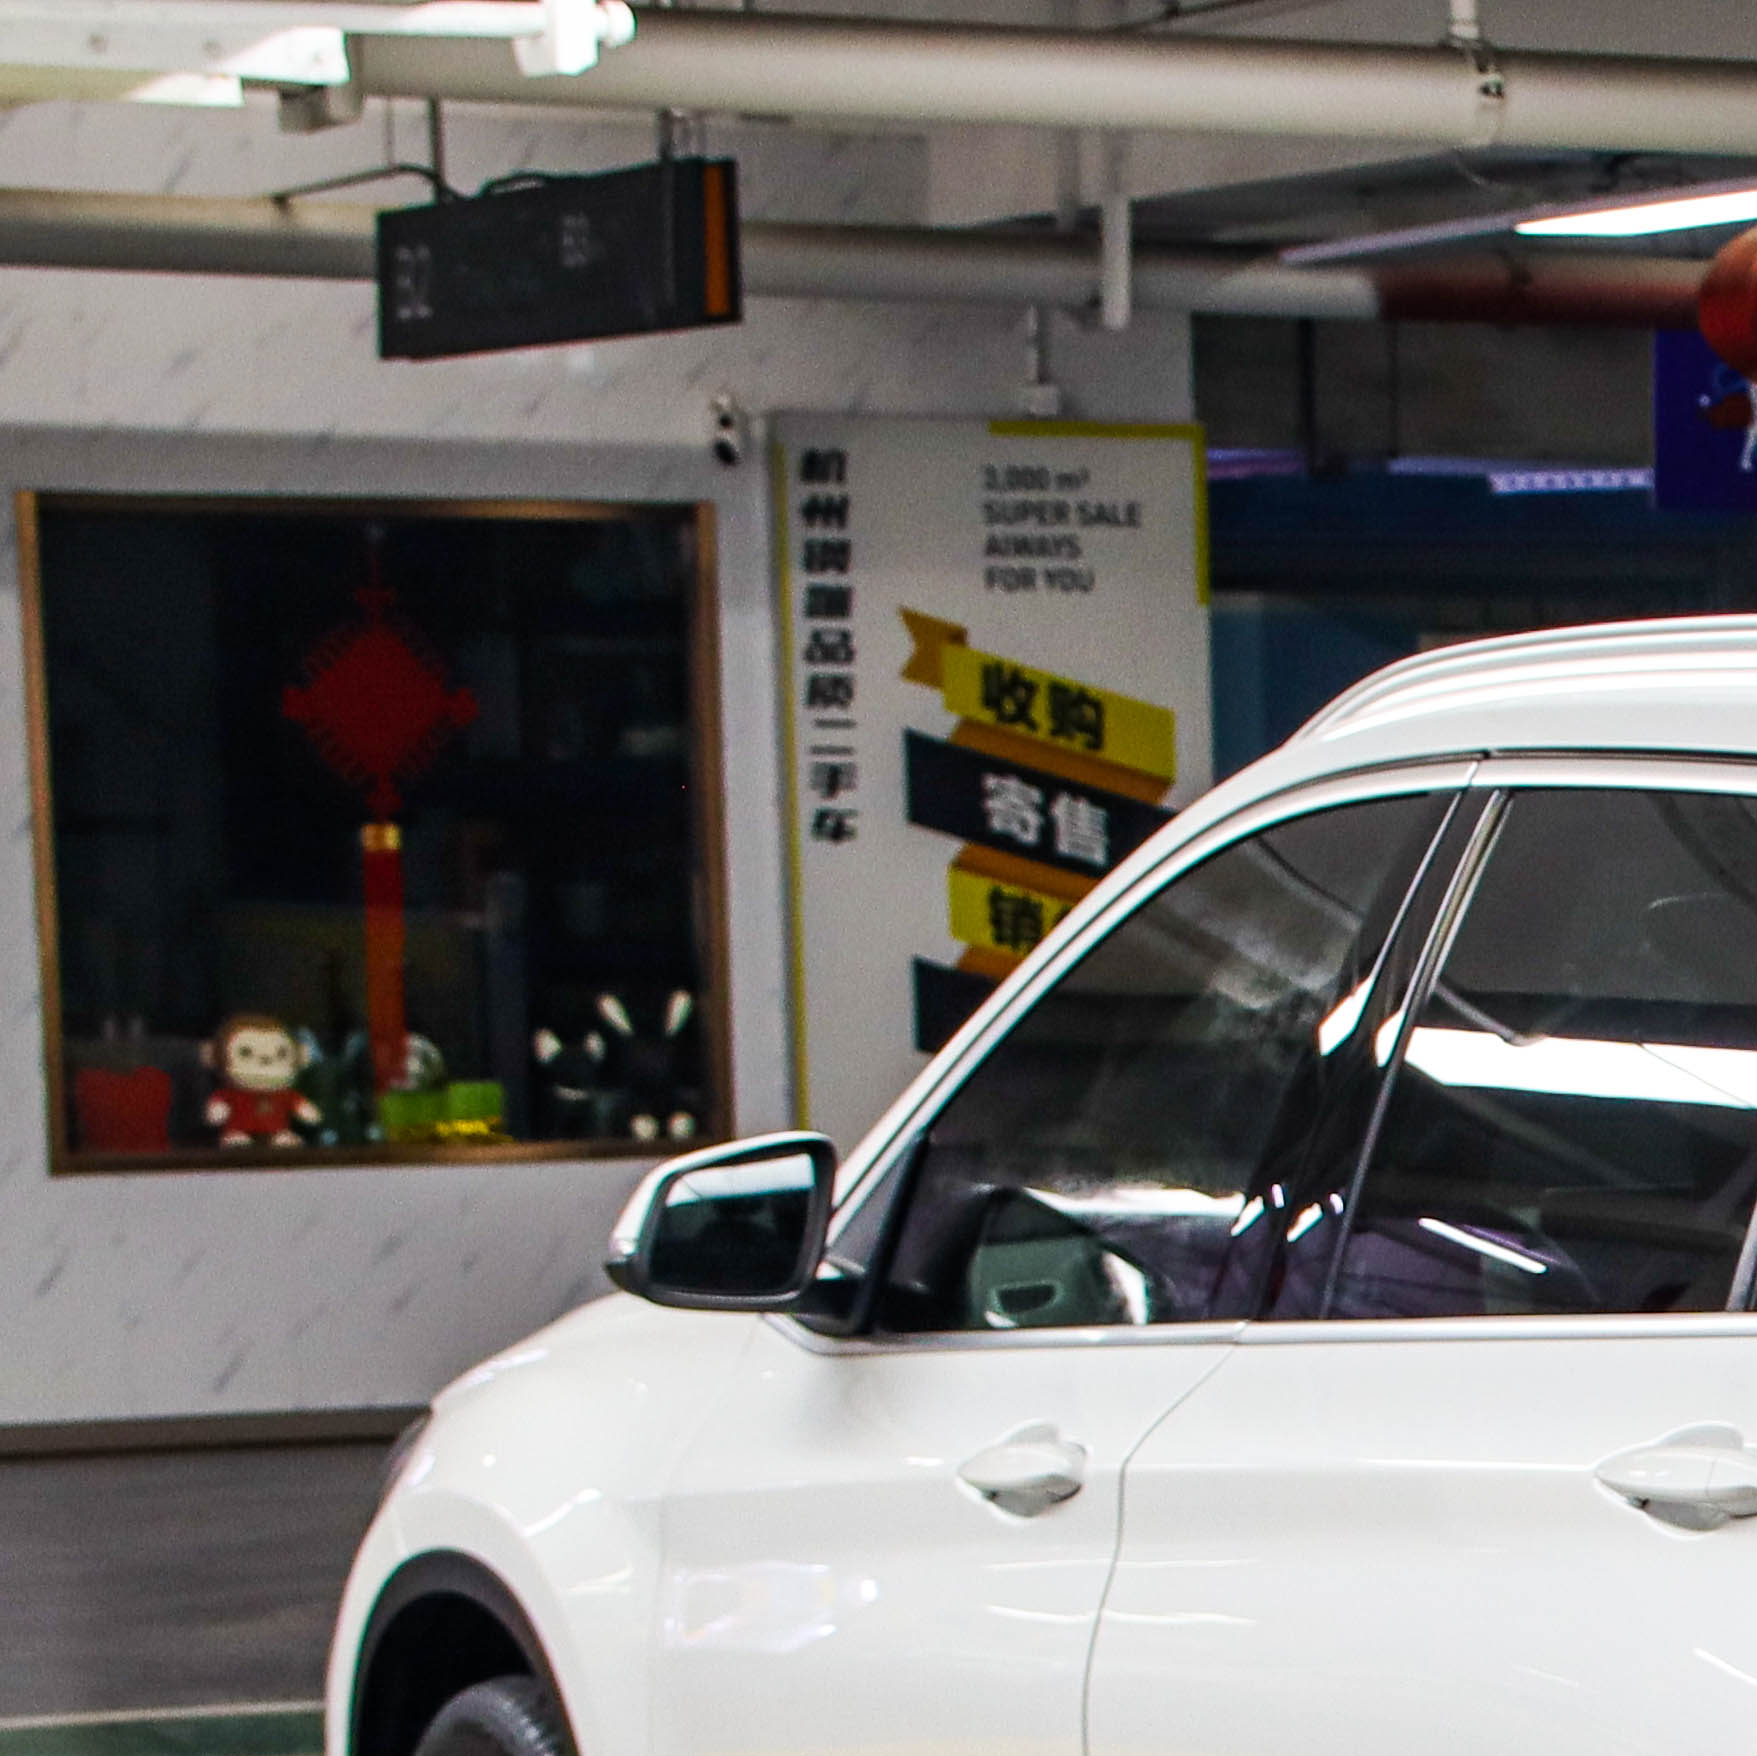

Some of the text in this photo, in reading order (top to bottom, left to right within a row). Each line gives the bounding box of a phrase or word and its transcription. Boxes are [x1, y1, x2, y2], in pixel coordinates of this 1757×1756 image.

[983, 499, 1142, 528] SUPER SALE
[984, 533, 1082, 560] ALWAYS
[984, 565, 1096, 594] FOR YOU
[982, 660, 1105, 751] 收购
[981, 771, 1110, 866] 寄售
